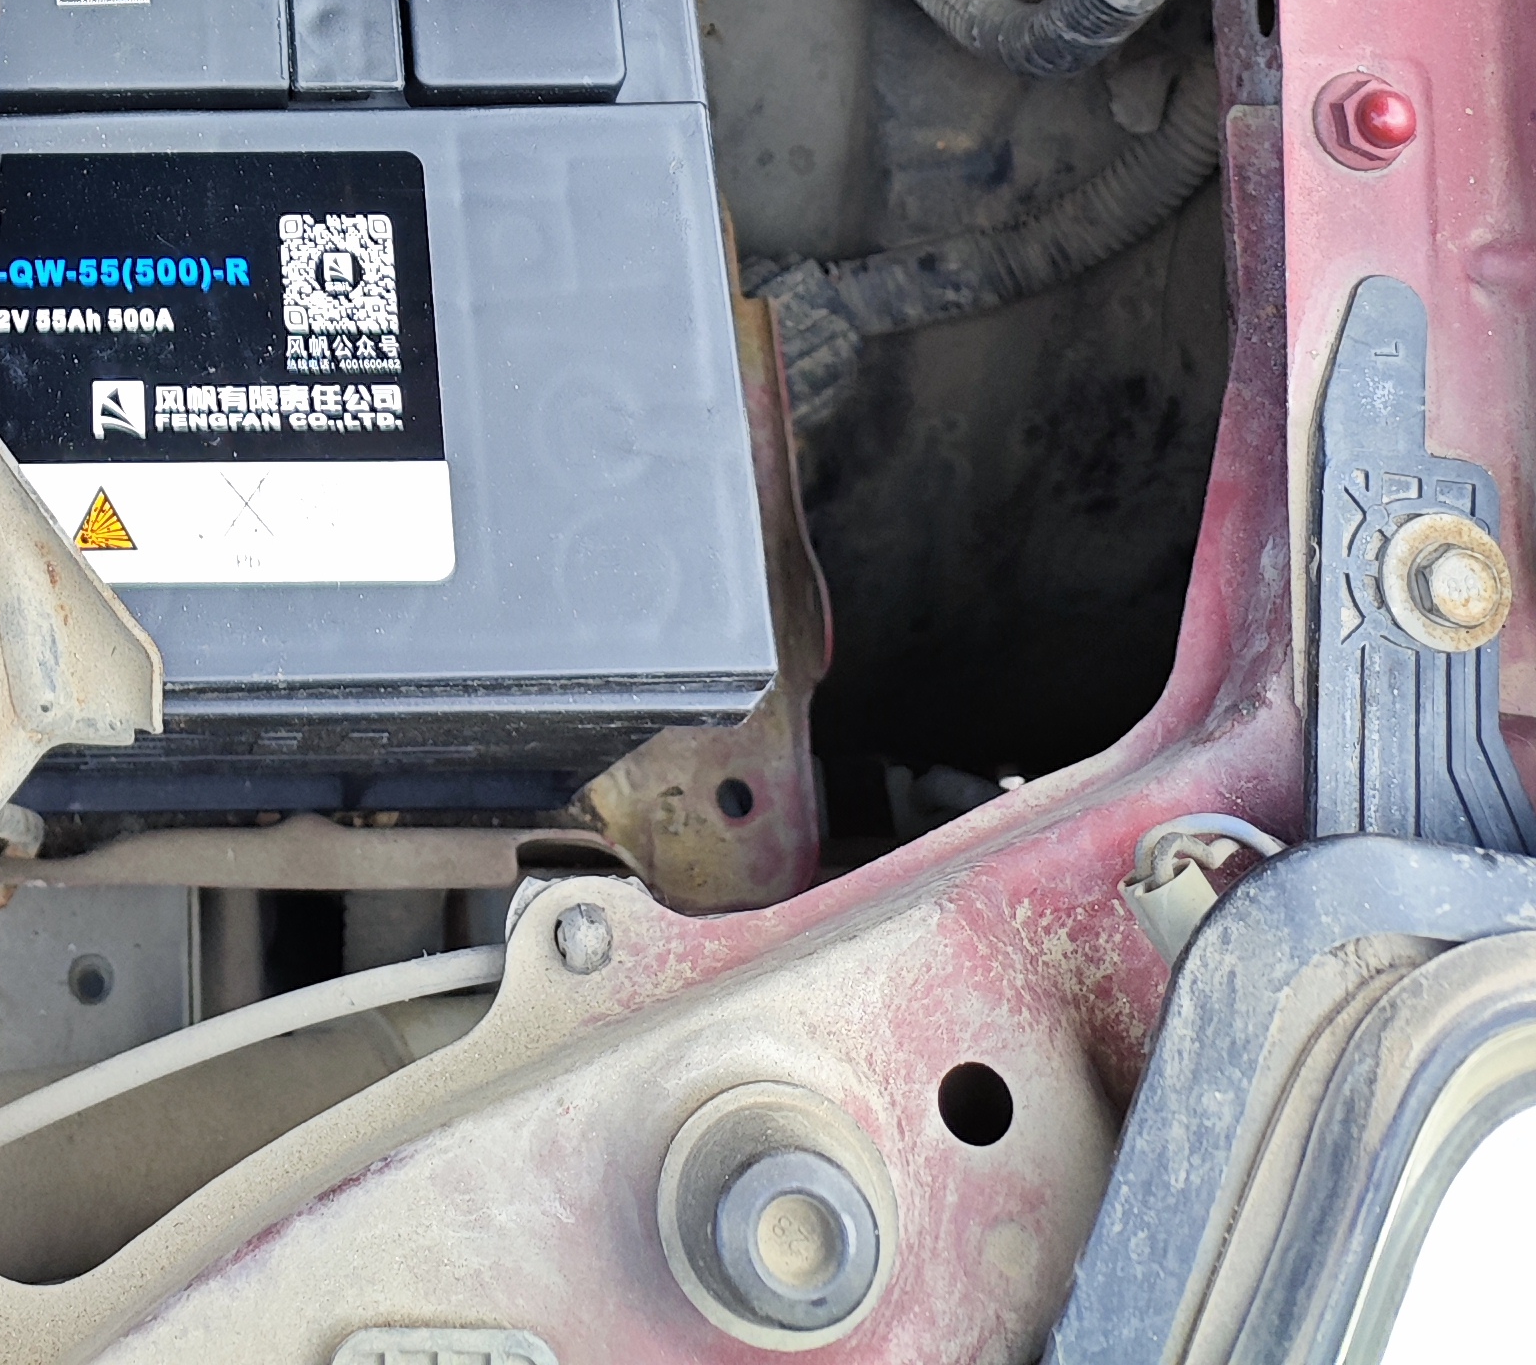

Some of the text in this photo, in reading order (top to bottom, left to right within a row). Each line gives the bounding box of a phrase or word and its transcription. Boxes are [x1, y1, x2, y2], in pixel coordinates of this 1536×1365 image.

[35, 307, 102, 335] 55Ah
[107, 306, 175, 333] 500A
[286, 334, 400, 359] 风帆公众号
[154, 384, 404, 414] 风帆有限责任公司
[154, 412, 282, 432] FENGFAN
